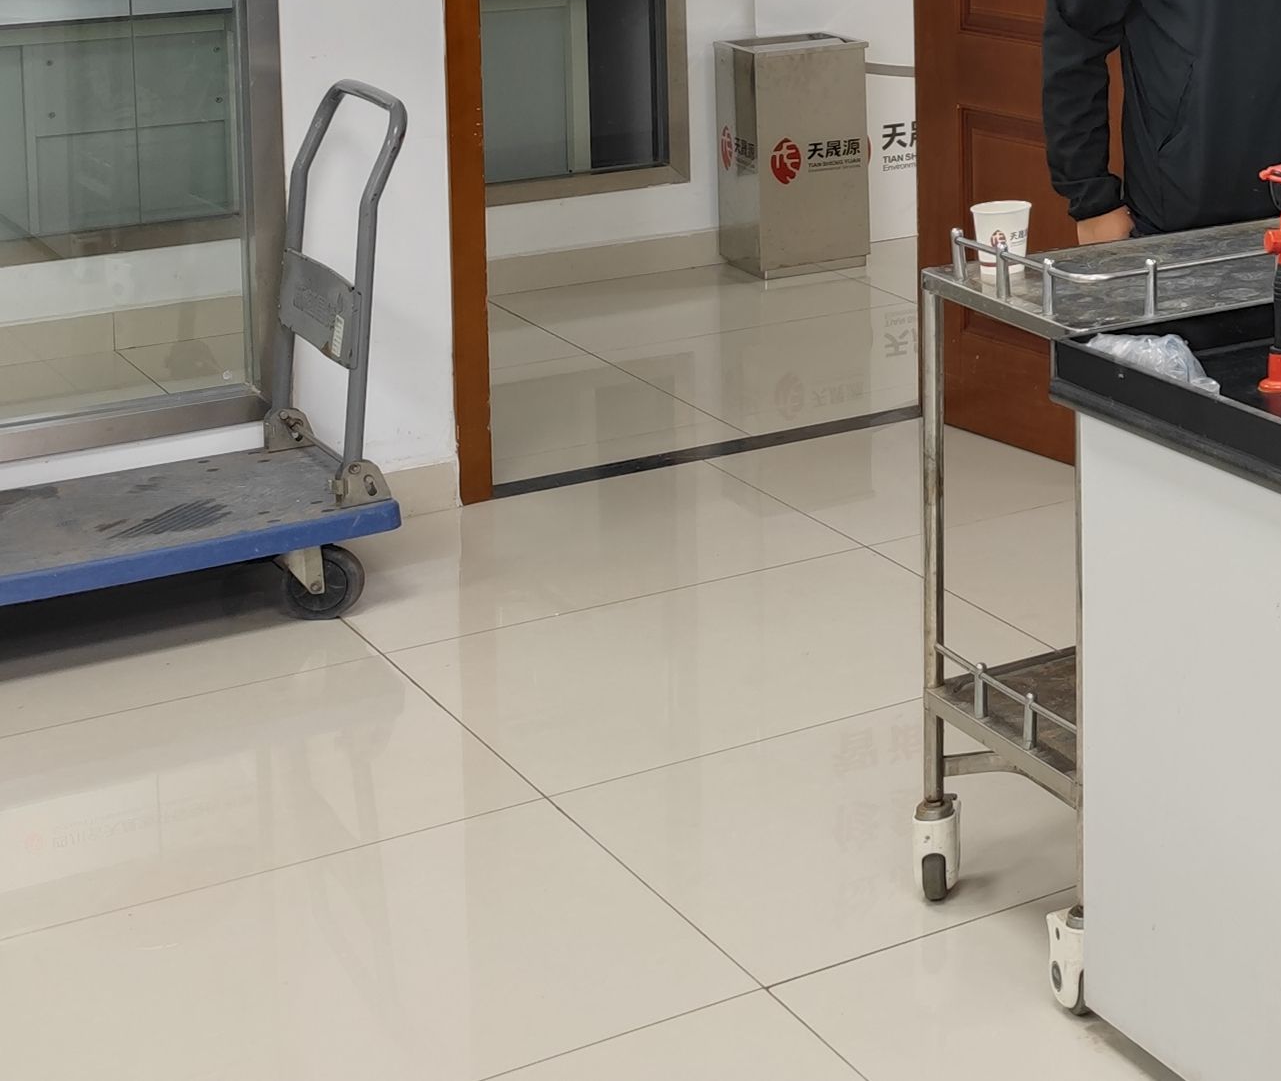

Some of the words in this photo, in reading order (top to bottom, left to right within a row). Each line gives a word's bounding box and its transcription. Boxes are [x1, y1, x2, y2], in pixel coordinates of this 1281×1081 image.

[807, 138, 861, 160] 天晟源
[883, 154, 904, 164] TIAN
